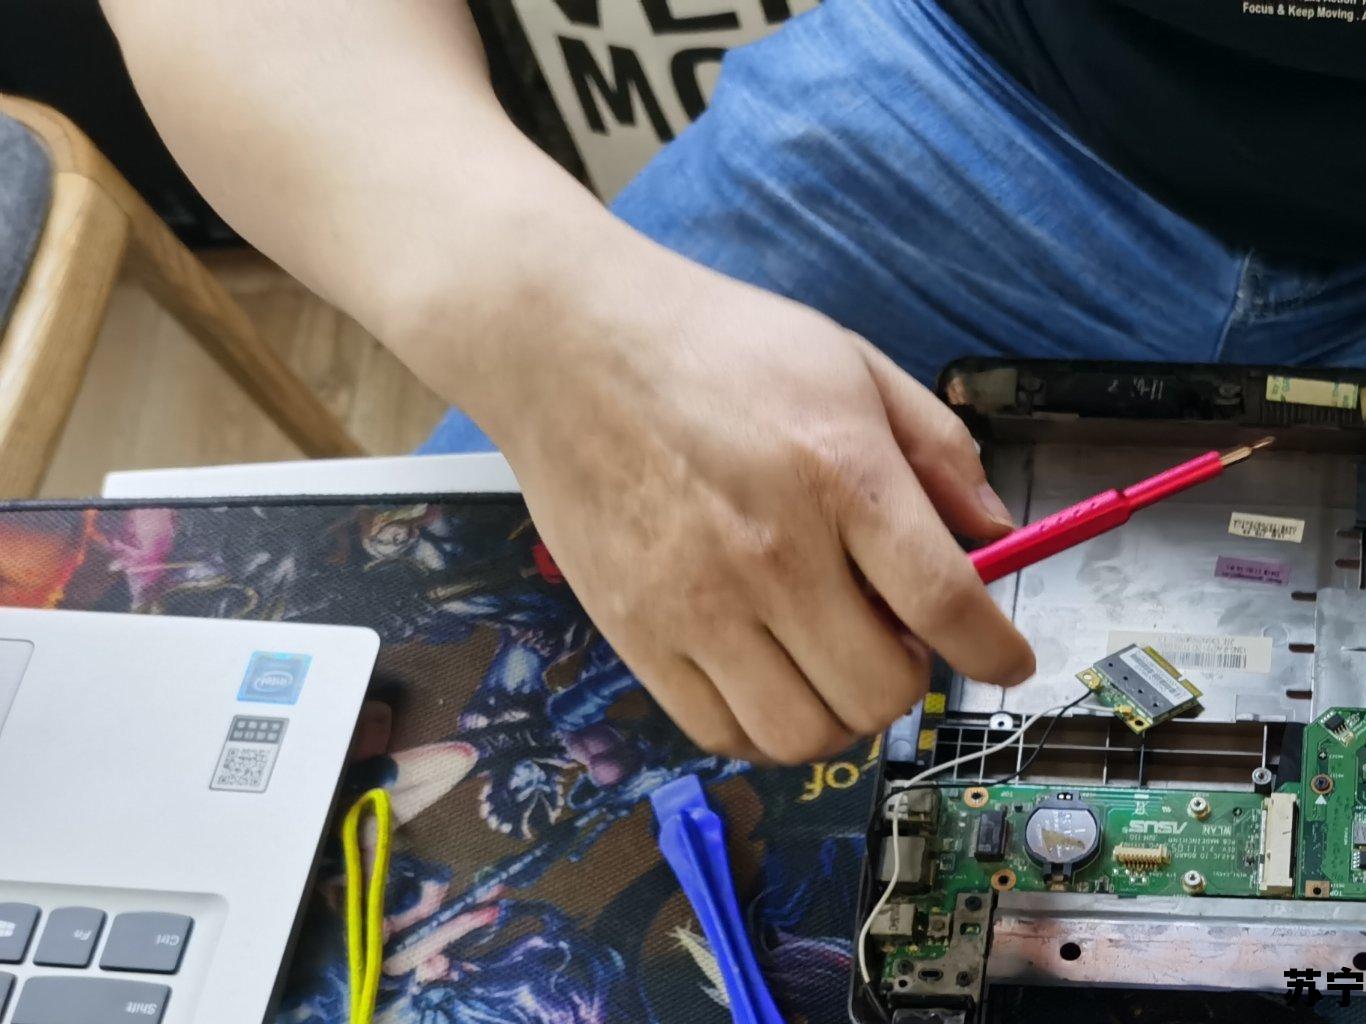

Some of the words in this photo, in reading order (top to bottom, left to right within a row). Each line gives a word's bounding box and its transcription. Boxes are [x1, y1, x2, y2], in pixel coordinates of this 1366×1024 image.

[1242, 2, 1274, 15] Focus
[1277, 4, 1285, 16] &
[1288, 5, 1315, 20] Keep
[1316, 6, 1354, 22] Moving
[1129, 820, 1188, 834] ASUS
[1202, 825, 1232, 836] WLAN
[73, 929, 92, 941] Fn
[156, 933, 180, 946] Ctrl
[126, 1001, 157, 1016] Shift
